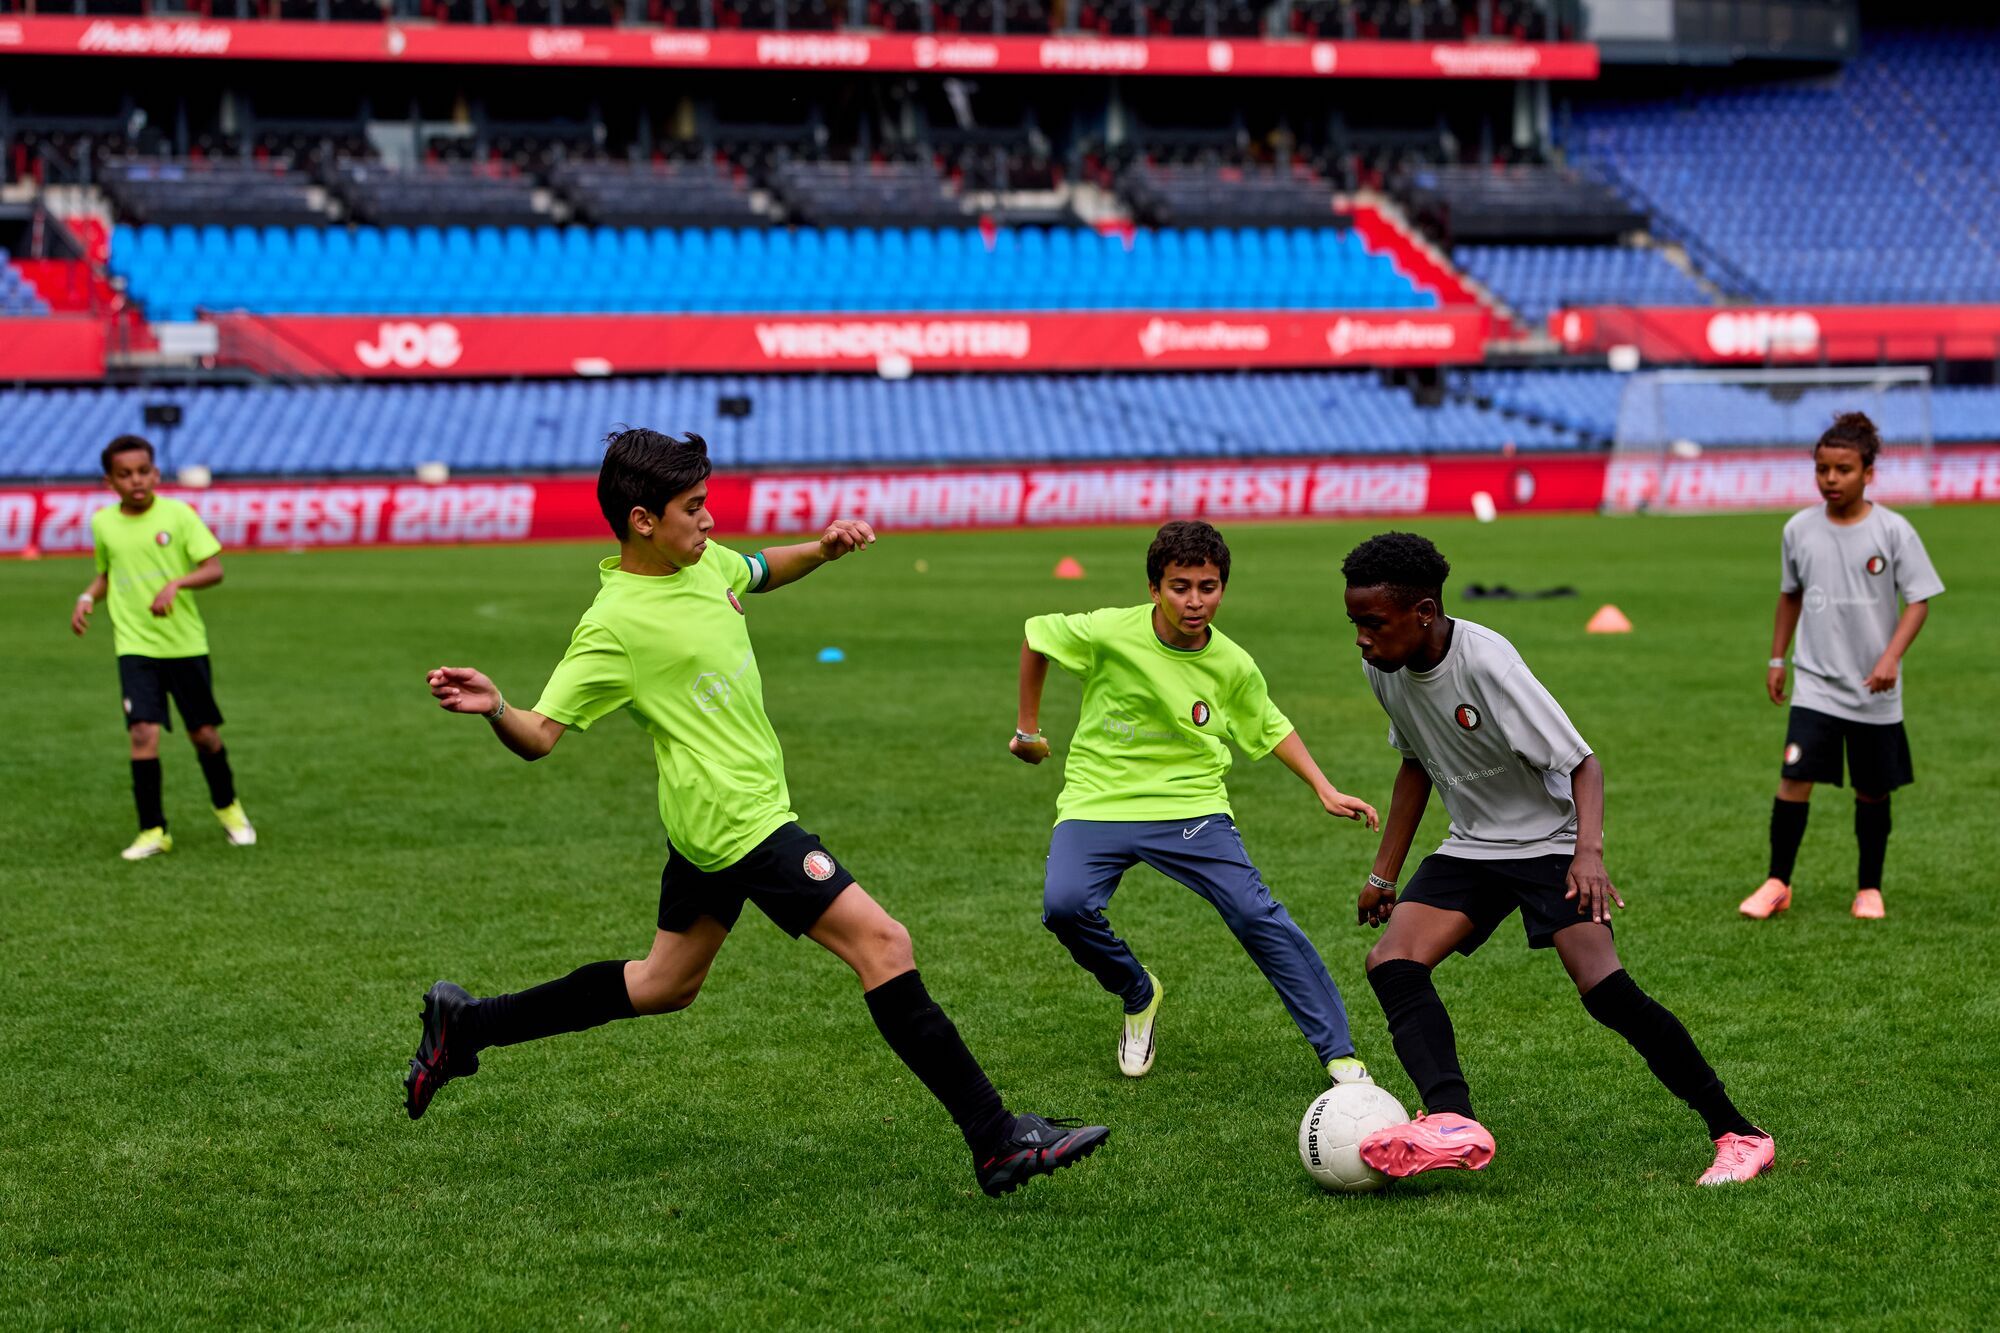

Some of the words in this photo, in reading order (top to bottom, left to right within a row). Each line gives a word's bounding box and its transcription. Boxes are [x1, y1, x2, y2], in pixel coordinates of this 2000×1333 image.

[388, 484, 536, 542] 2026
[750, 473, 1025, 533] FEYENOORD
[1309, 464, 1429, 513] 2026
[1307, 1098, 1331, 1167] DERBYSTAR
